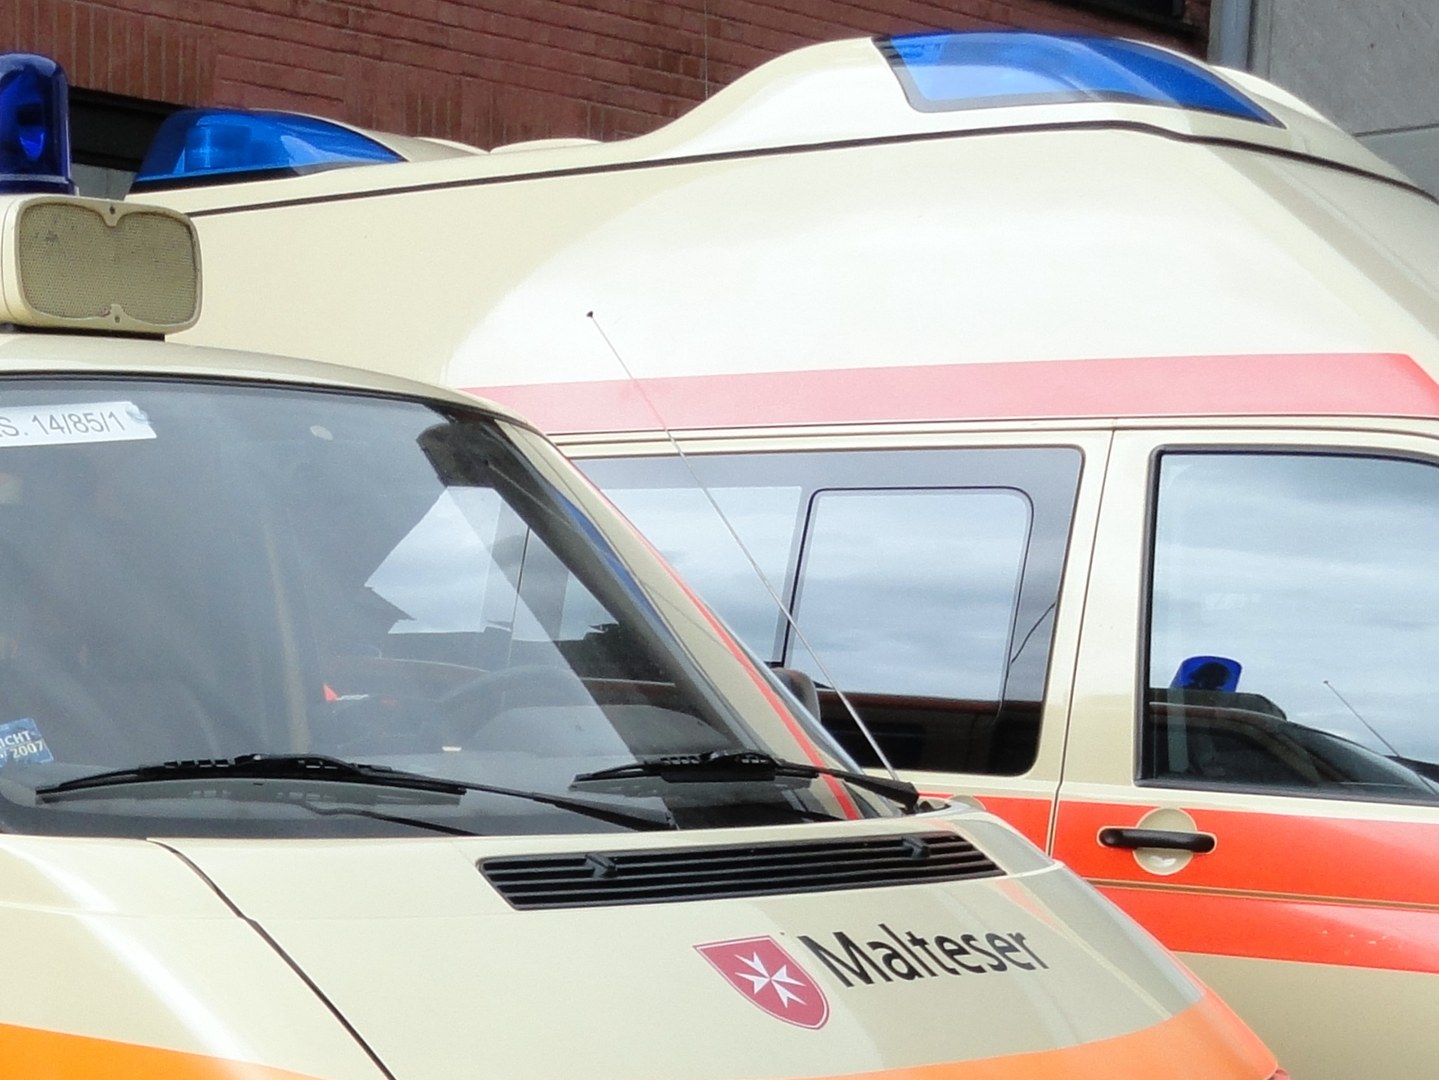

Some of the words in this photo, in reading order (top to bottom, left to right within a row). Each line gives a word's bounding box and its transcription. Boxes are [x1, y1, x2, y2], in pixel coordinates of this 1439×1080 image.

[32, 410, 126, 436] 14/85/1
[10, 740, 43, 758] 2007
[797, 923, 1050, 988] Malteser
